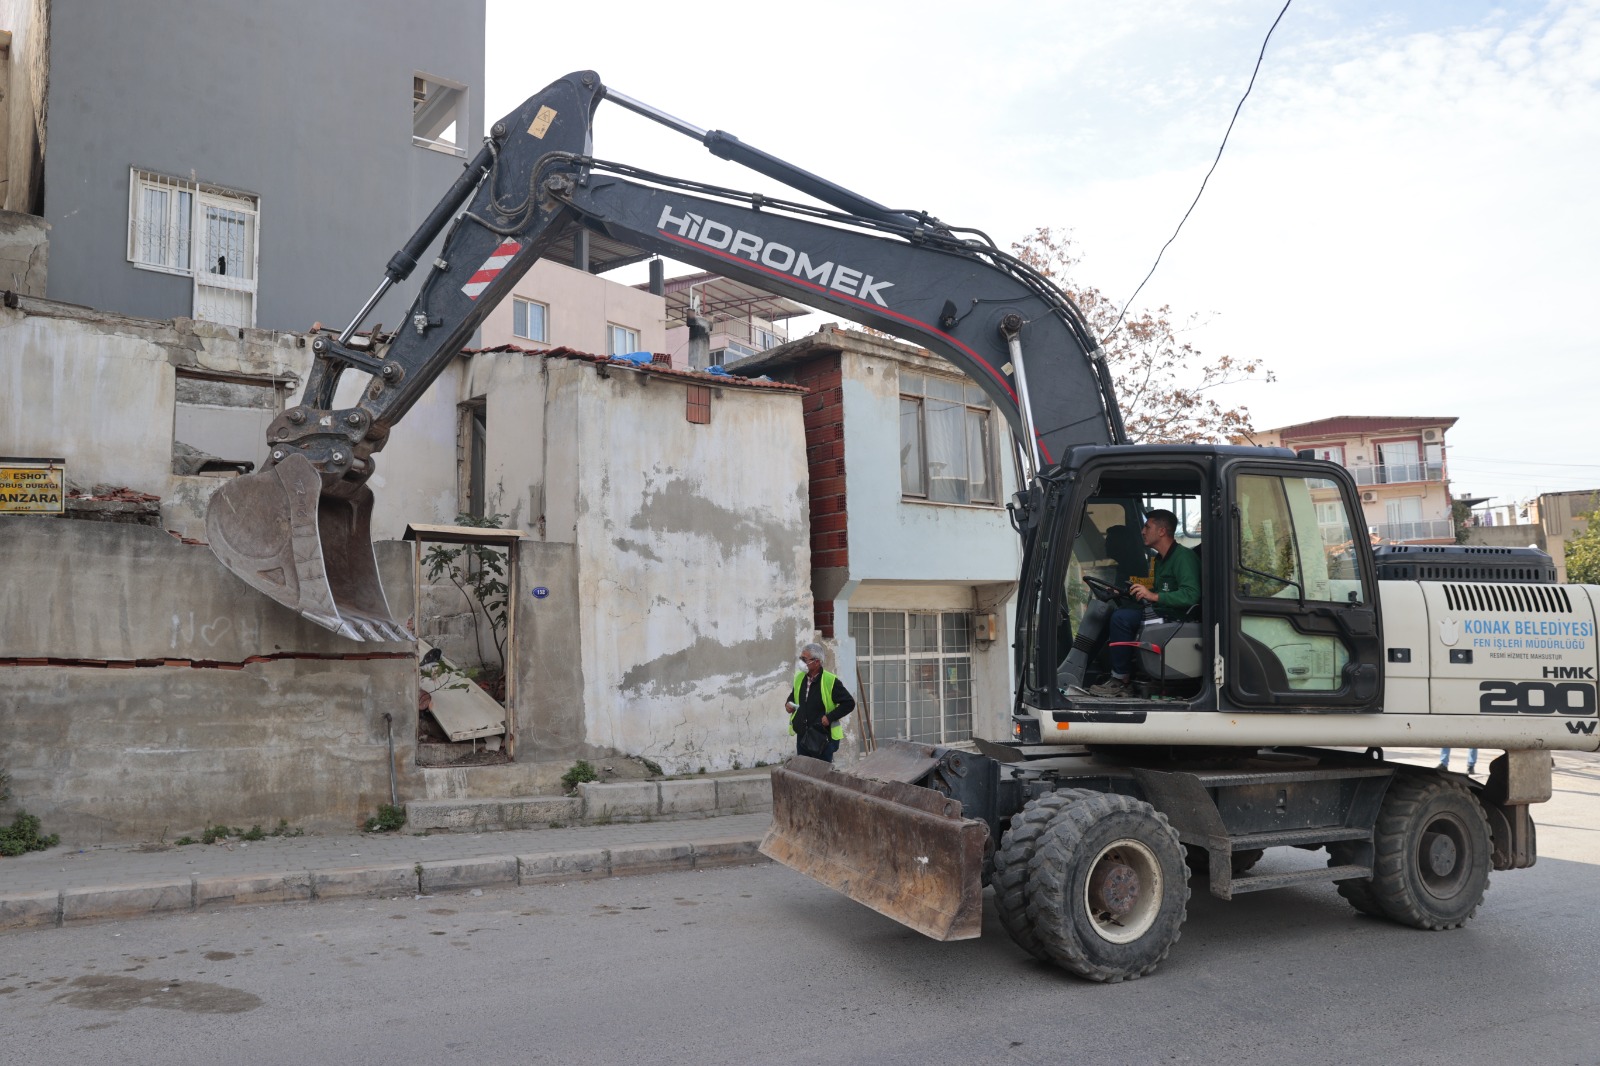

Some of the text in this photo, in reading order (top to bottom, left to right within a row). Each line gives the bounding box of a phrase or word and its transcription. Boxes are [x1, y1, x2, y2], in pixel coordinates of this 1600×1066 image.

[0, 493, 58, 503] ANZARA
[1464, 619, 1593, 637] KONAK BELEDİYESİ
[1473, 637, 1585, 651] FEN İŞLERİ MÜDÜRLÜĞÜ
[1542, 666, 1595, 680] HMK
[1479, 681, 1596, 716] 200
[1564, 721, 1598, 735] W
